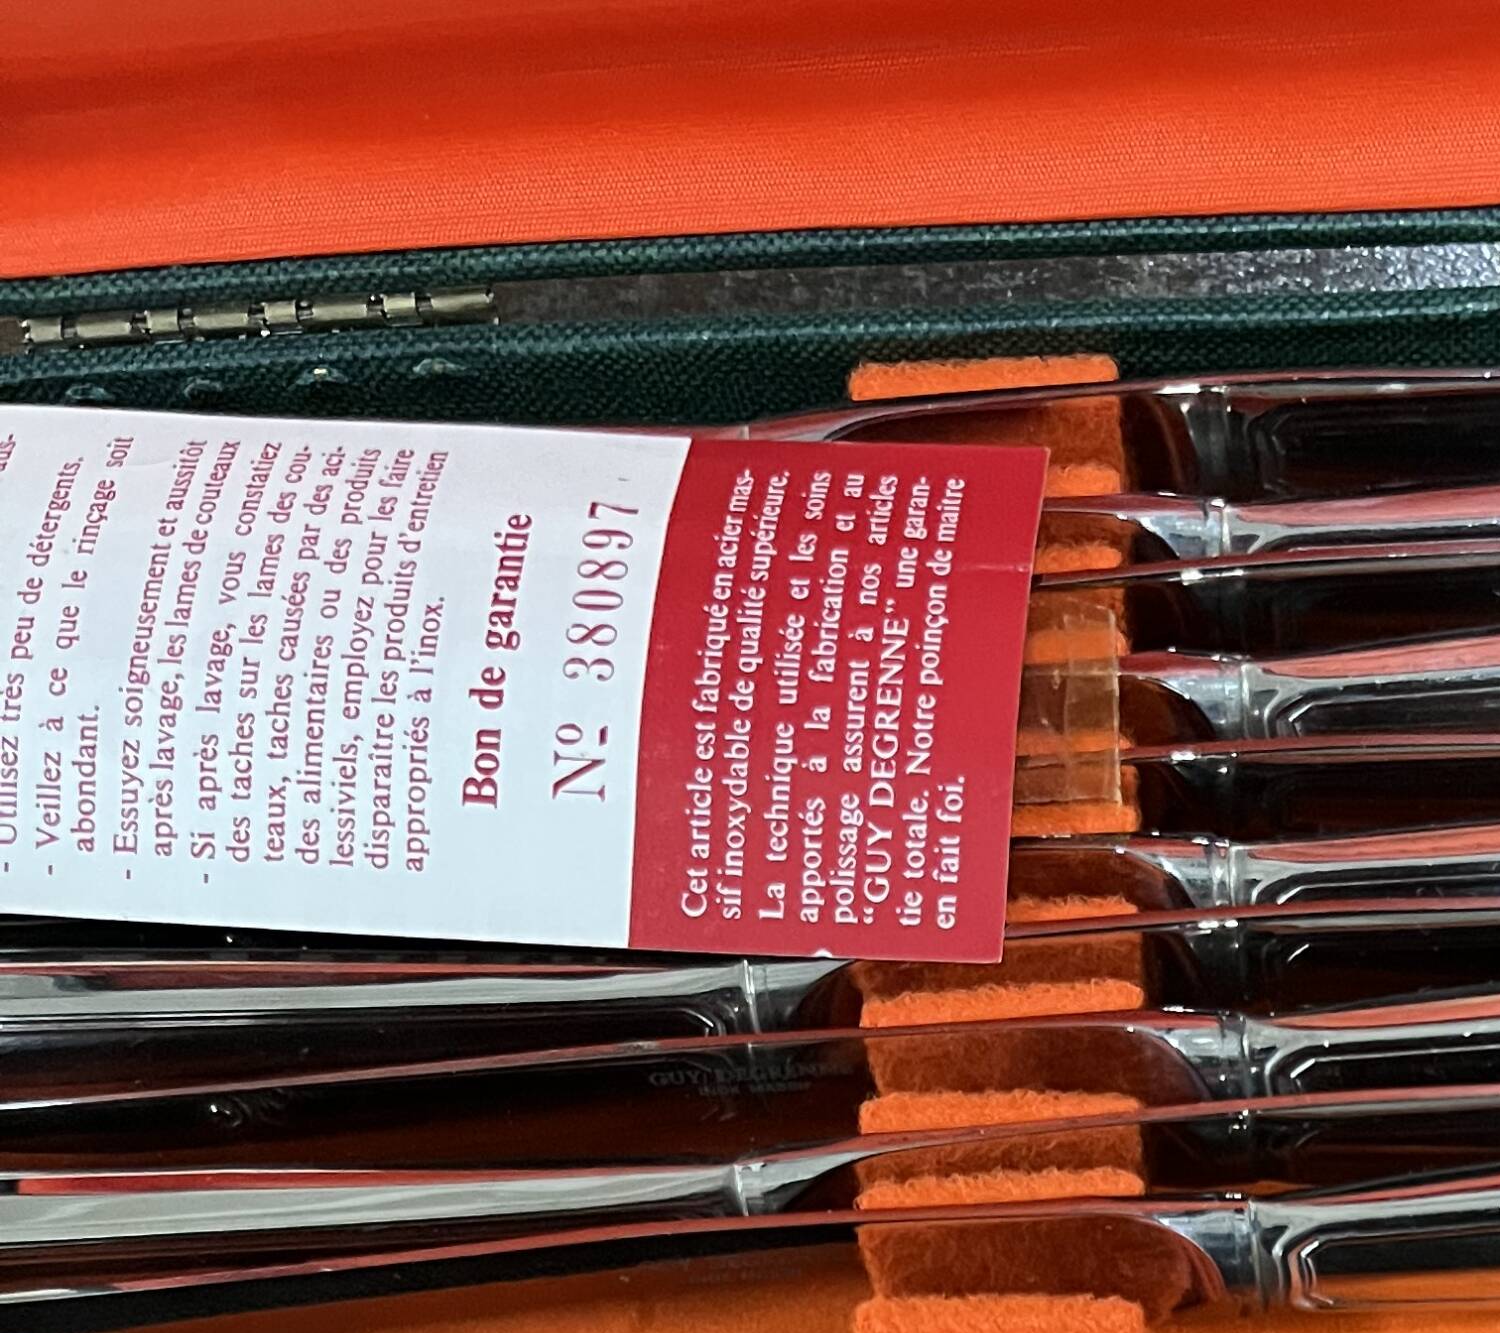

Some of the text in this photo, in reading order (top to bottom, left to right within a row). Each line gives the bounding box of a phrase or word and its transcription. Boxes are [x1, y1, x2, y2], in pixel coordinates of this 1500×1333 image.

[106, 436, 134, 467] soit
[166, 439, 207, 511] aussitôt
[235, 442, 282, 536] constatiez
[26, 456, 83, 567] détergents.
[72, 479, 116, 555] rinçage
[158, 517, 178, 537] et
[903, 475, 930, 539] garan-
[17, 576, 43, 604] de
[61, 569, 88, 589] le
[218, 551, 246, 605] vous
[563, 500, 639, 681] 380897
[896, 546, 918, 588] une
[926, 547, 952, 576] de
[11, 616, 35, 660] peu
[56, 605, 80, 649] que
[120, 543, 171, 727] soigneusement
[148, 440, 240, 857] après lavage, les lames de couteaux
[225, 445, 312, 862] des taches sur les lames des cou-
[263, 445, 346, 862] teaux, taches causées par des aci-
[294, 448, 381, 864] des alimentaires ou des produits
[384, 560, 417, 661] produits
[915, 582, 949, 685] poinçon
[0, 672, 24, 722] très
[49, 667, 68, 696] ce
[195, 622, 236, 714] lavage,
[329, 448, 415, 867] lessiviels, employez pour les faire
[371, 670, 399, 704] les
[406, 687, 432, 703] à
[462, 514, 532, 809] Bon de garantie
[681, 467, 754, 917] Cet article est fabriqué en acier mas-
[715, 470, 790, 919] sif inoxydable de qualité supérieure.
[758, 470, 831, 919] La technique utilisée et les soins
[798, 472, 864, 923] apportés à la fabrication et au
[829, 474, 898, 924] polissage assurent à nos articles
[38, 715, 64, 732] à
[905, 693, 936, 775] Notre
[0, 735, 18, 845] Utilisez
[35, 751, 61, 849] Veillez
[70, 704, 99, 852] abondant.
[113, 739, 144, 855] Essuyez
[193, 733, 222, 811] après
[363, 712, 395, 869] disparaître
[402, 716, 432, 872] appropriés
[190, 831, 215, 859] Si
[902, 789, 929, 879] totale.
[932, 775, 965, 929] en fait foi.
[895, 890, 923, 926] tie
[649, 1069, 703, 1087] GUY
